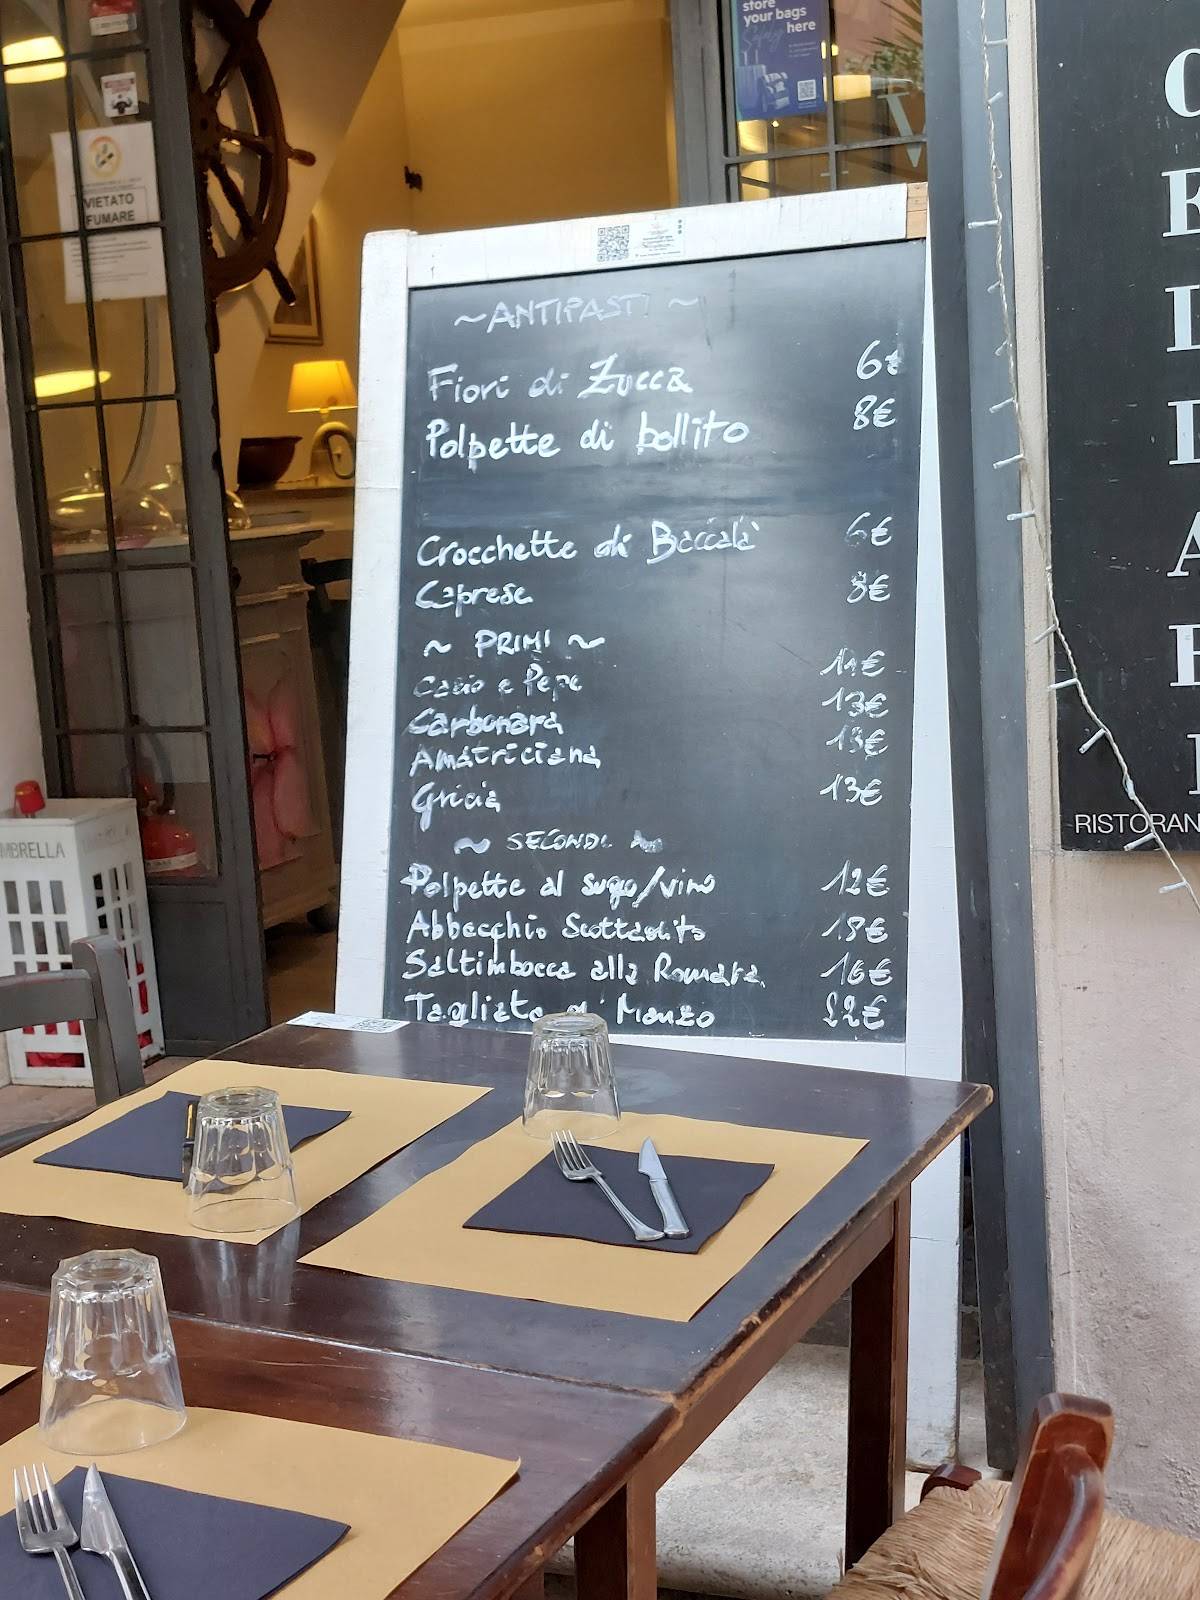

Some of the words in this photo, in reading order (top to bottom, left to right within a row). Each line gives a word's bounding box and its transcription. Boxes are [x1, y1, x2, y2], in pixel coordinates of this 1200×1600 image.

[743, 0, 776, 11] store
[744, 12, 774, 27] your
[775, 7, 807, 20] bags
[787, 21, 816, 33] here
[84, 192, 135, 210] VIETATO
[86, 210, 136, 227] FUMARE
[486, 292, 650, 334] ANTIPASTI
[427, 362, 510, 404] Fiori
[528, 366, 569, 398] di
[577, 353, 694, 398] Zucca
[425, 418, 561, 474] Polpette
[580, 418, 614, 452] di
[636, 410, 750, 456] bollito
[853, 394, 897, 430] 8€
[416, 529, 578, 567] Crocchette
[593, 524, 632, 558] di
[844, 511, 893, 548] 6€
[415, 580, 534, 618] Caprese
[846, 570, 891, 603] 8€
[474, 629, 551, 658] PRIMI
[498, 677, 515, 694] e
[405, 704, 564, 738] Carbonara
[821, 687, 889, 718] 13€
[408, 743, 601, 777] Amatriciana
[819, 773, 883, 806] 13€
[401, 863, 526, 912] Polpette
[540, 870, 563, 897] al
[820, 859, 891, 897] 12€
[402, 948, 577, 980] Saltimbocca
[590, 953, 639, 985] alla
[820, 951, 893, 986] 16€
[822, 991, 888, 1030] 22€
